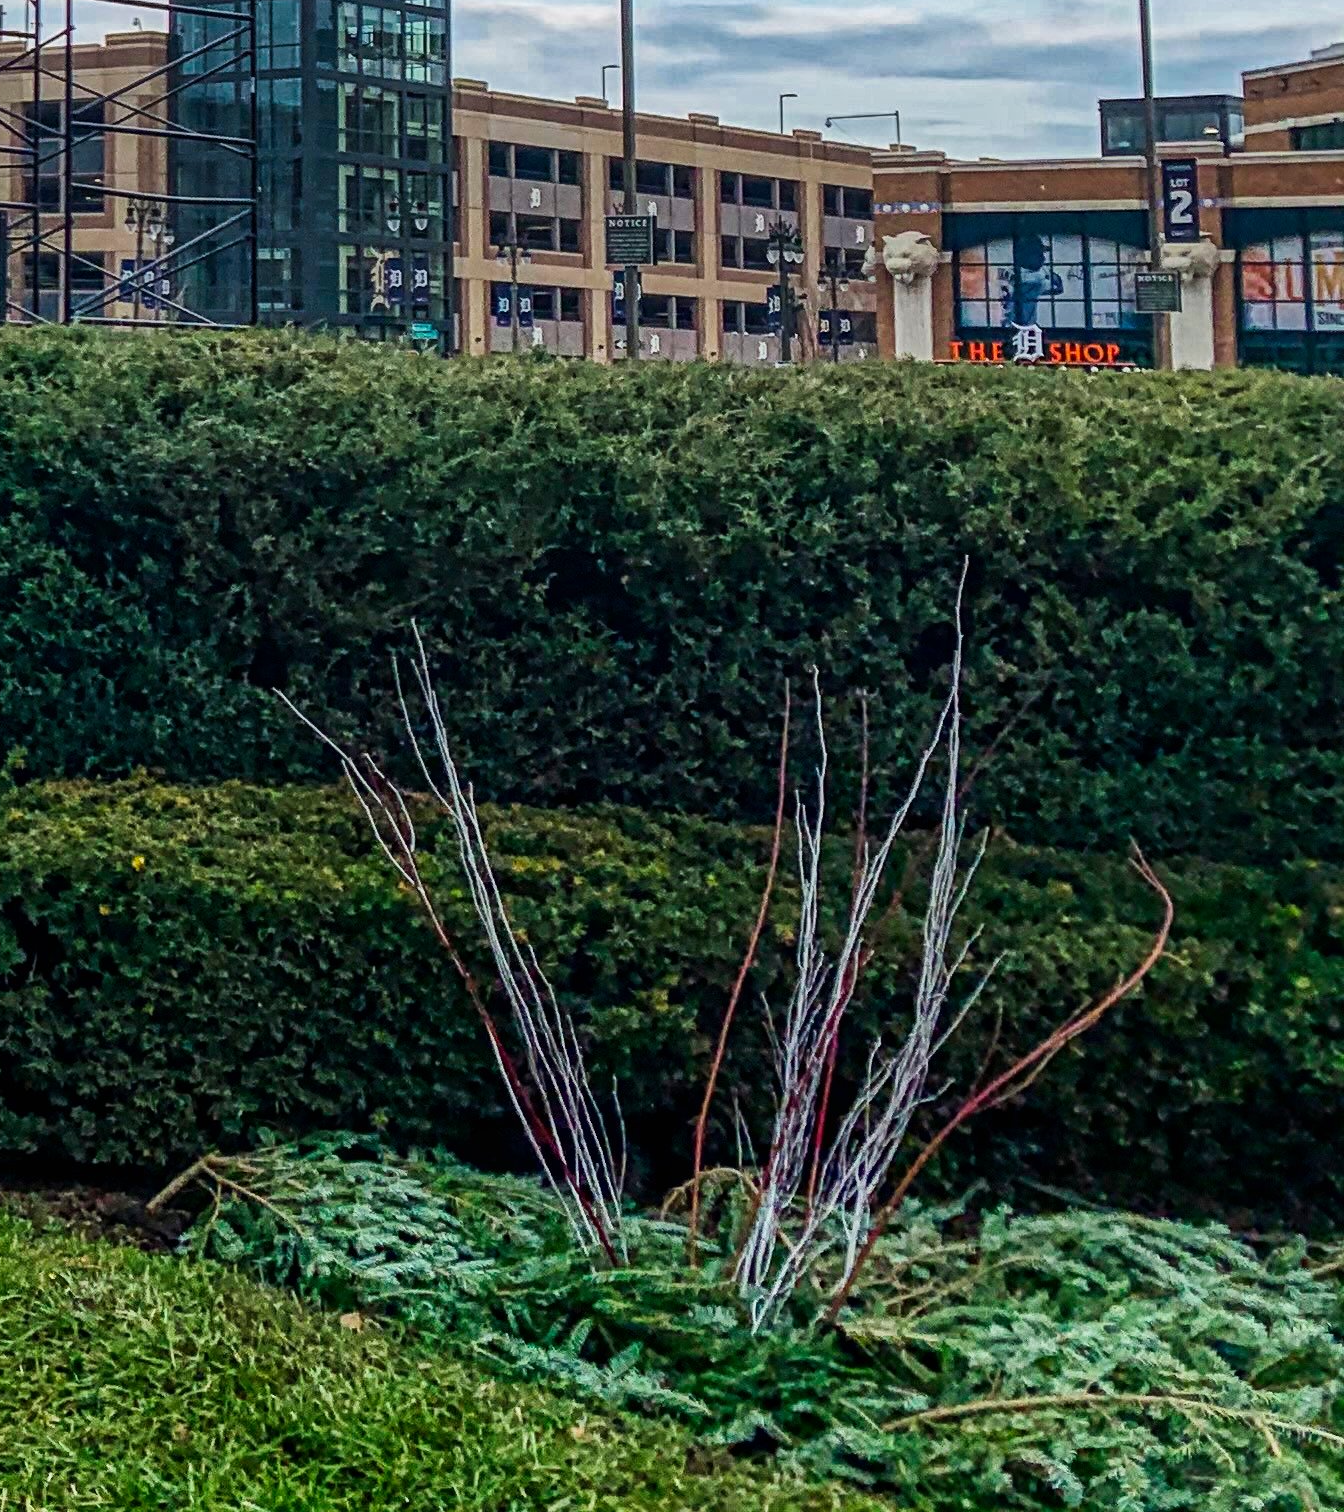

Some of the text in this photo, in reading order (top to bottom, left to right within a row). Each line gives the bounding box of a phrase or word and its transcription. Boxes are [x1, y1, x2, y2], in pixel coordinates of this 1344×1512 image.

[1169, 178, 1189, 188] LOT
[530, 188, 541, 209] D
[1170, 190, 1193, 224] 2
[608, 219, 648, 228] NOTICE
[390, 269, 402, 287] D
[415, 269, 428, 288] D
[498, 297, 510, 313] D
[519, 297, 531, 313] D
[820, 319, 830, 333] D
[840, 319, 851, 333] D
[949, 321, 1120, 364] THE D SHOP
